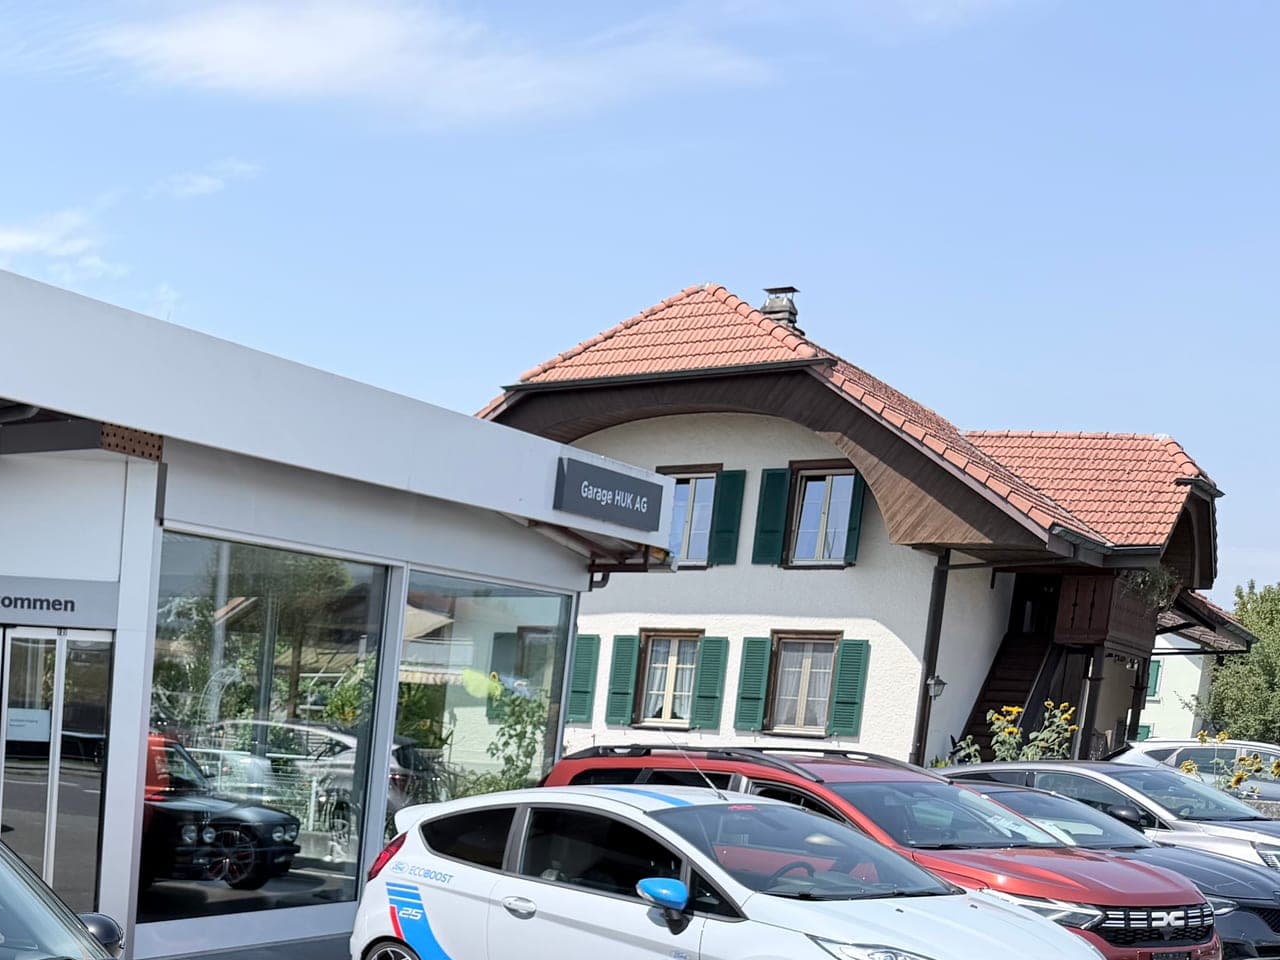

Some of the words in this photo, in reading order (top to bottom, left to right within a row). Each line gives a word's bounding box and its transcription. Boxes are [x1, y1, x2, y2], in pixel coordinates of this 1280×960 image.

[581, 481, 612, 505] Garage
[614, 489, 633, 509] HUK
[634, 495, 648, 512] AG
[408, 865, 454, 884] ECOBOOST
[399, 907, 424, 920] 25
